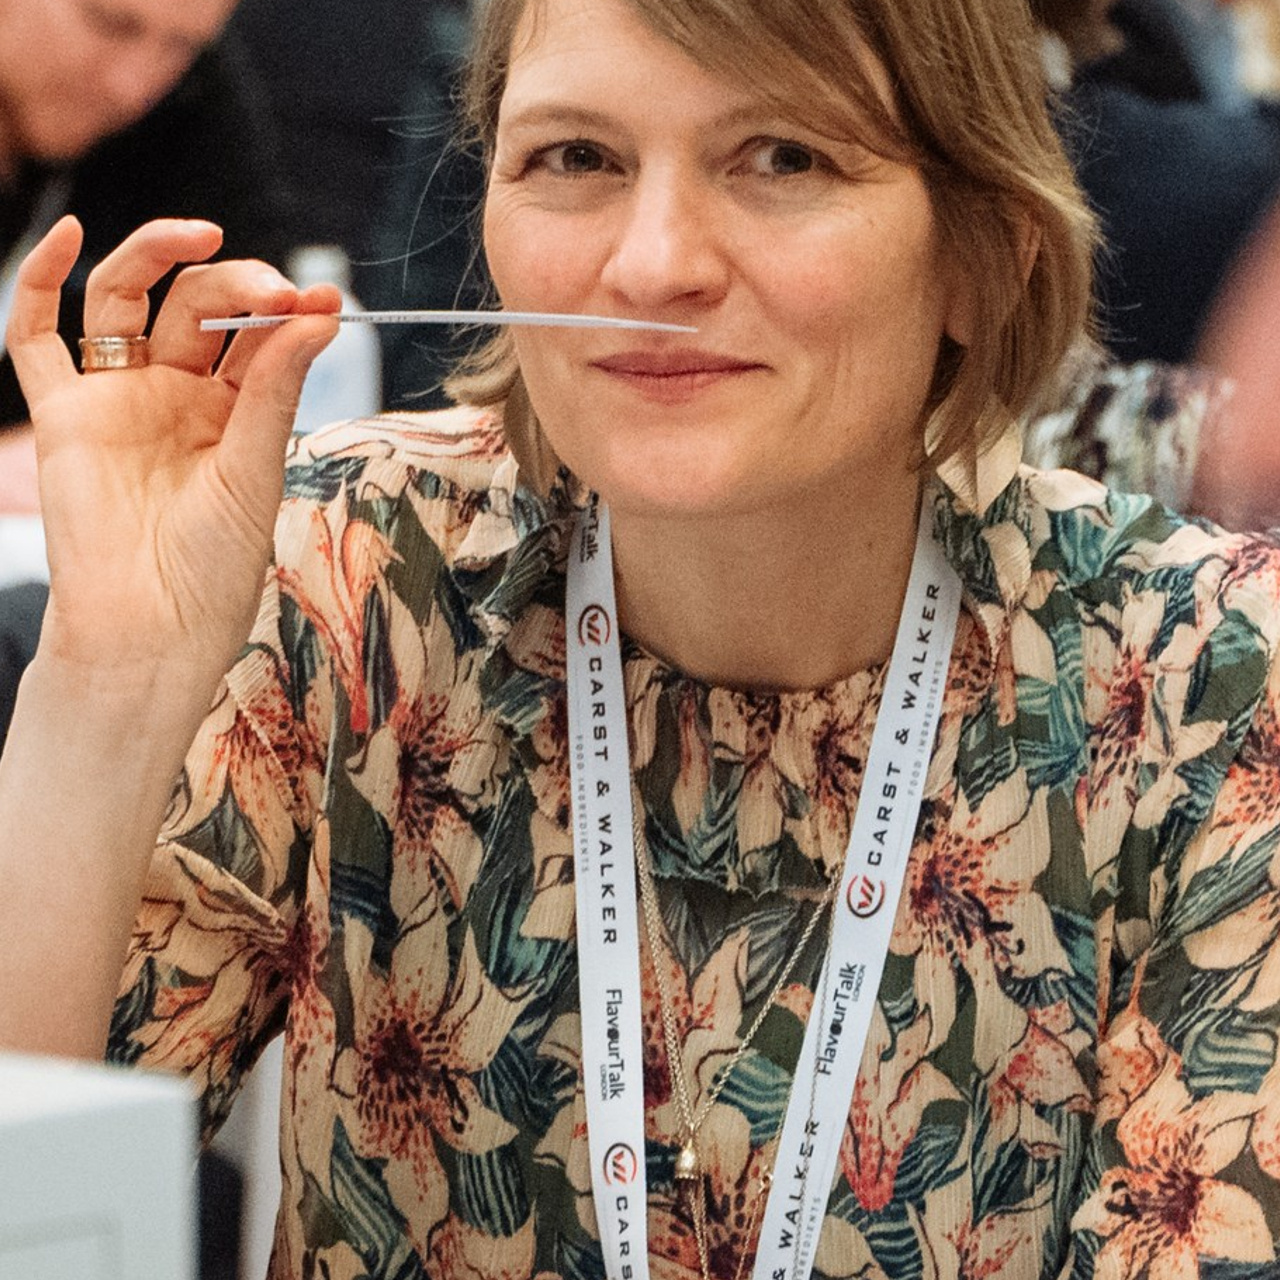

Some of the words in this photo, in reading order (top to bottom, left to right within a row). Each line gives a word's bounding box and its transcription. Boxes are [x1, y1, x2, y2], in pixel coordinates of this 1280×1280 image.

[901, 583, 940, 711] WALKER
[588, 657, 608, 761] CARST
[894, 728, 910, 745] &
[596, 780, 610, 797] &
[867, 762, 901, 866] CARST
[598, 813, 617, 945] WALKER
[820, 962, 858, 1076] FlavourTalk
[851, 964, 866, 1002] LONDON
[600, 1064, 608, 1101] LONDON
[606, 988, 625, 1100] FlavourTalk
[779, 1120, 820, 1249] WALKER
